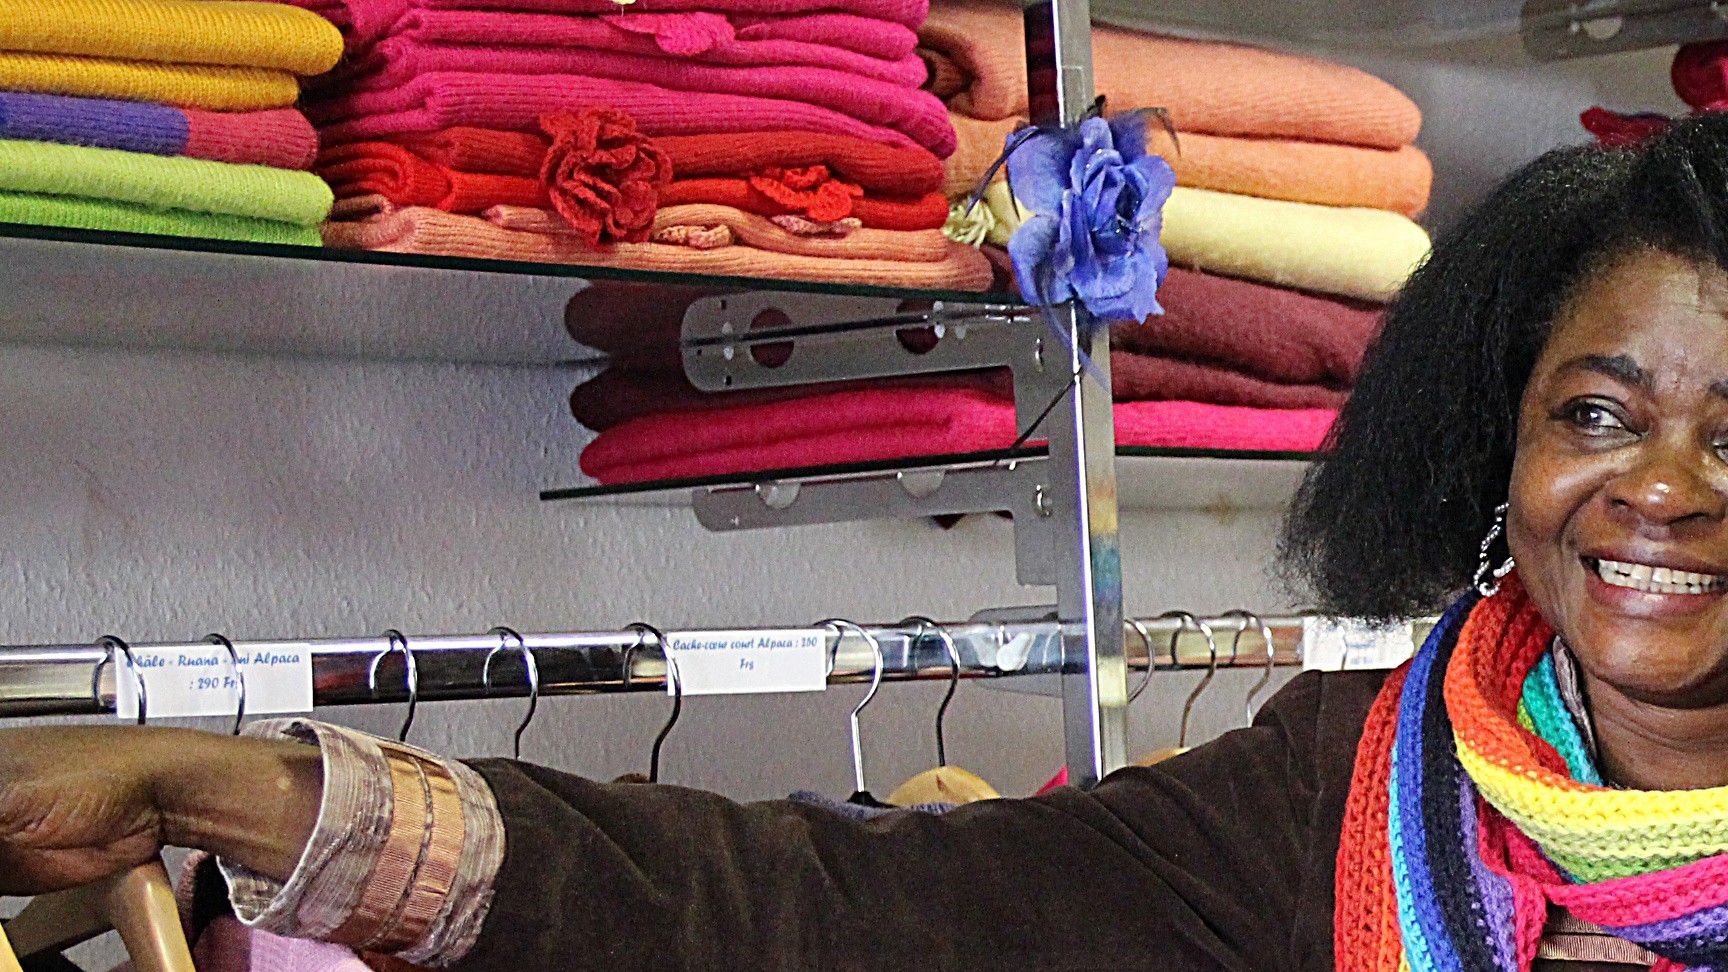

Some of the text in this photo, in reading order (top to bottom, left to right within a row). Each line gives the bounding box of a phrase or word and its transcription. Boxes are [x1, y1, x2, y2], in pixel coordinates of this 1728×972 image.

[730, 637, 755, 650] court
[757, 637, 793, 651] Alpaca
[178, 654, 219, 667] Ruana
[254, 652, 300, 666] Alpaca
[197, 677, 219, 689] 290
